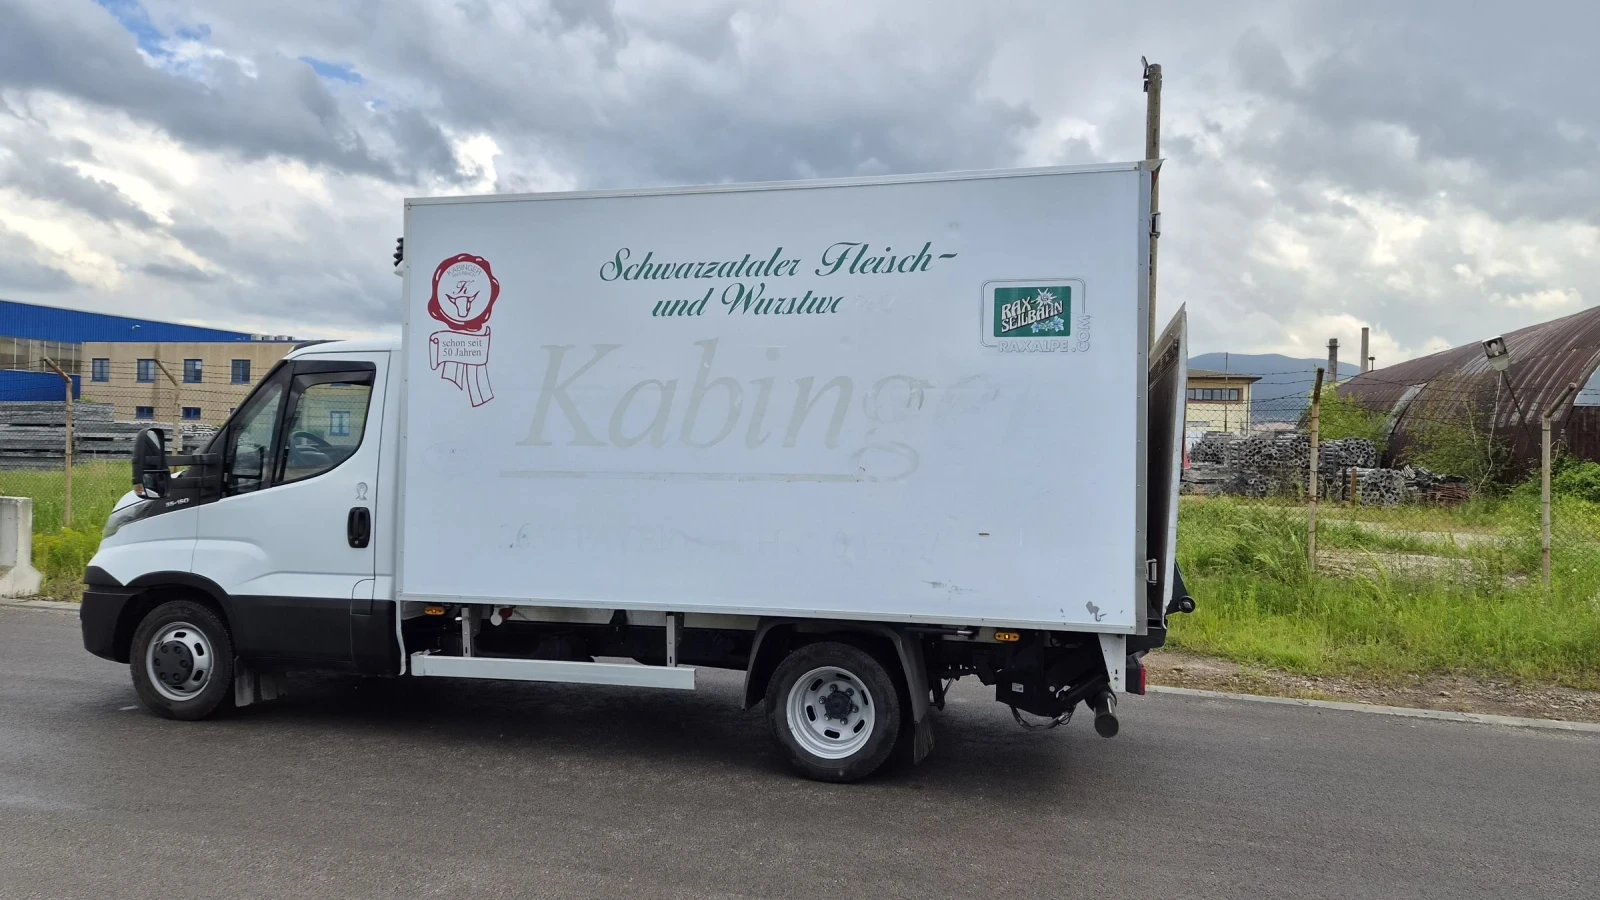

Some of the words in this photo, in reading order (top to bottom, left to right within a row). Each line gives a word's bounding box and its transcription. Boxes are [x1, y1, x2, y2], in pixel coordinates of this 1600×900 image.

[600, 247, 802, 281] Schwarzataler
[815, 241, 958, 277] Fleisch-
[652, 287, 715, 317] und
[1001, 300, 1063, 332] SEILBAHN
[442, 338, 465, 347] schon
[468, 338, 482, 347] seit
[443, 348, 452, 356] 50
[455, 348, 481, 357] Jahren
